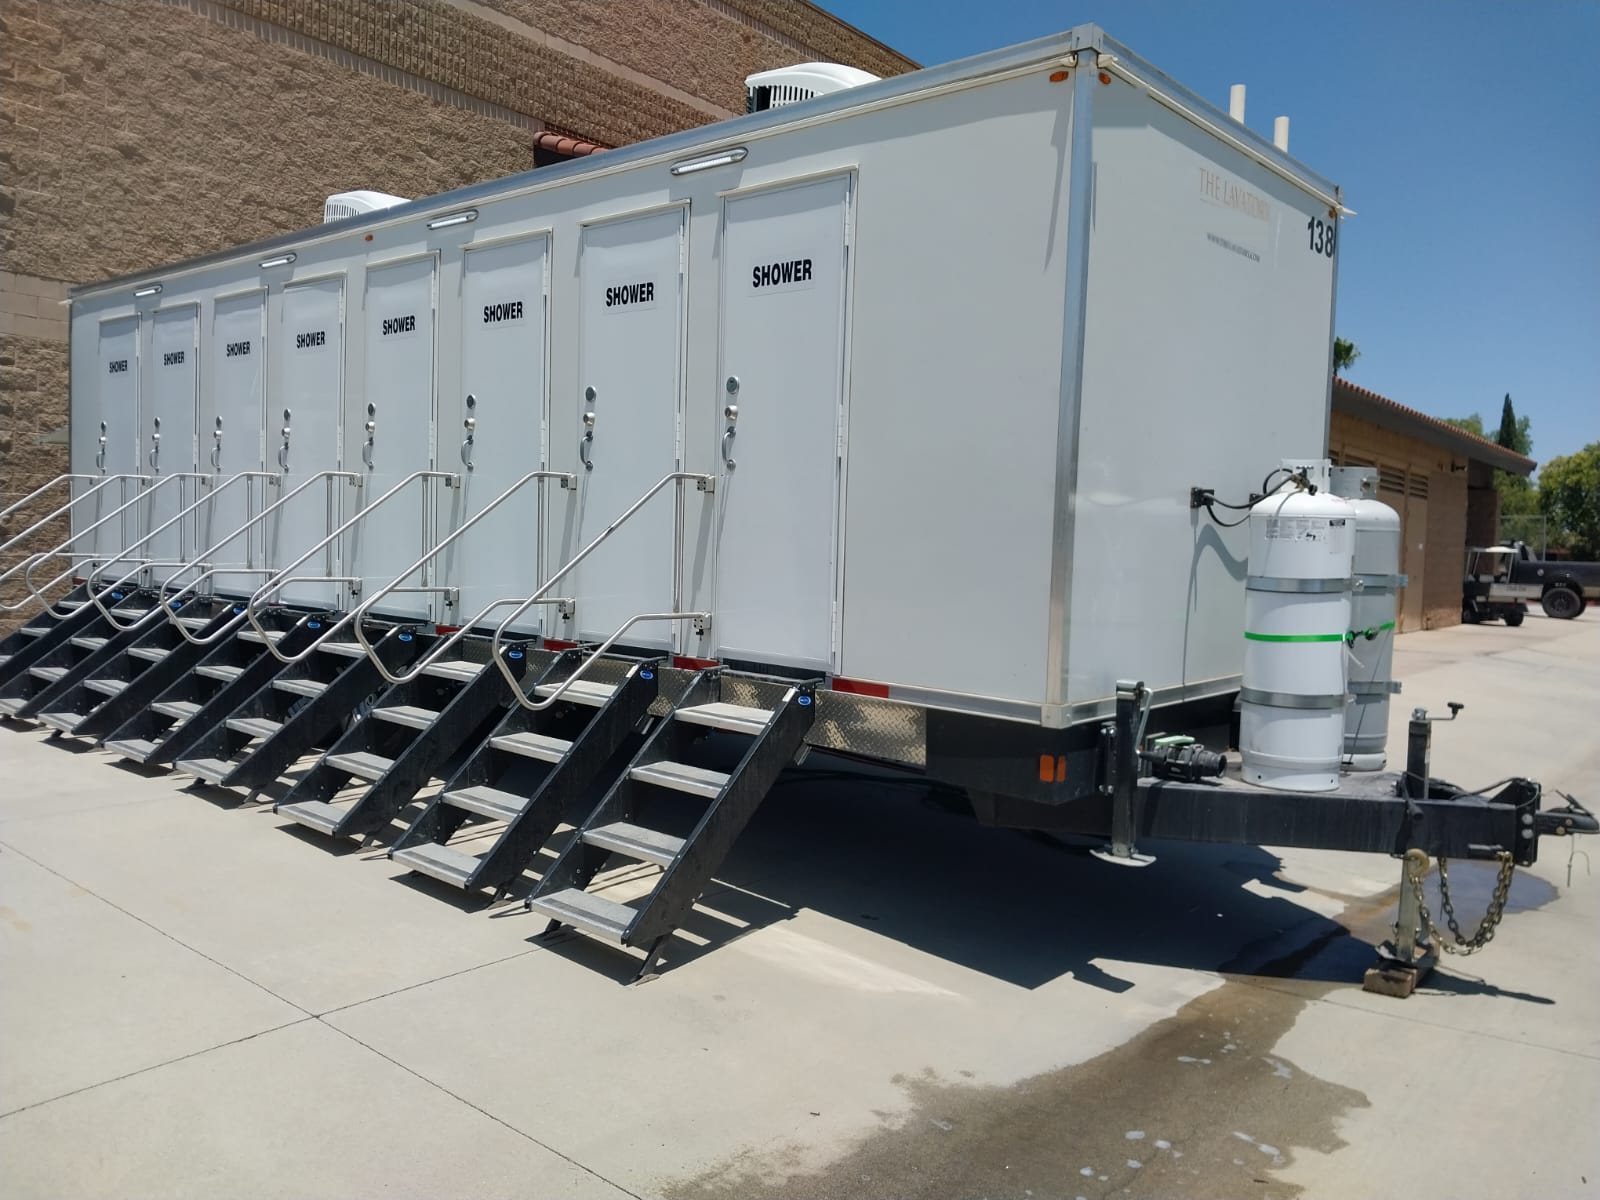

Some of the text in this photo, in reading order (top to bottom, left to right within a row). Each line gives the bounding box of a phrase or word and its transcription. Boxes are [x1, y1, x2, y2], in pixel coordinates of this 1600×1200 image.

[1199, 167, 1221, 201] THE
[1307, 215, 1334, 258] 138
[752, 259, 813, 289] SHOWER
[605, 282, 655, 308] SHOWER
[483, 301, 524, 324] SHOWER
[382, 315, 416, 336] SHOWER
[226, 341, 251, 358] SHOWER
[296, 331, 326, 349] SHOWER
[108, 359, 129, 374] SHOWER
[163, 351, 185, 367] SHOWER
